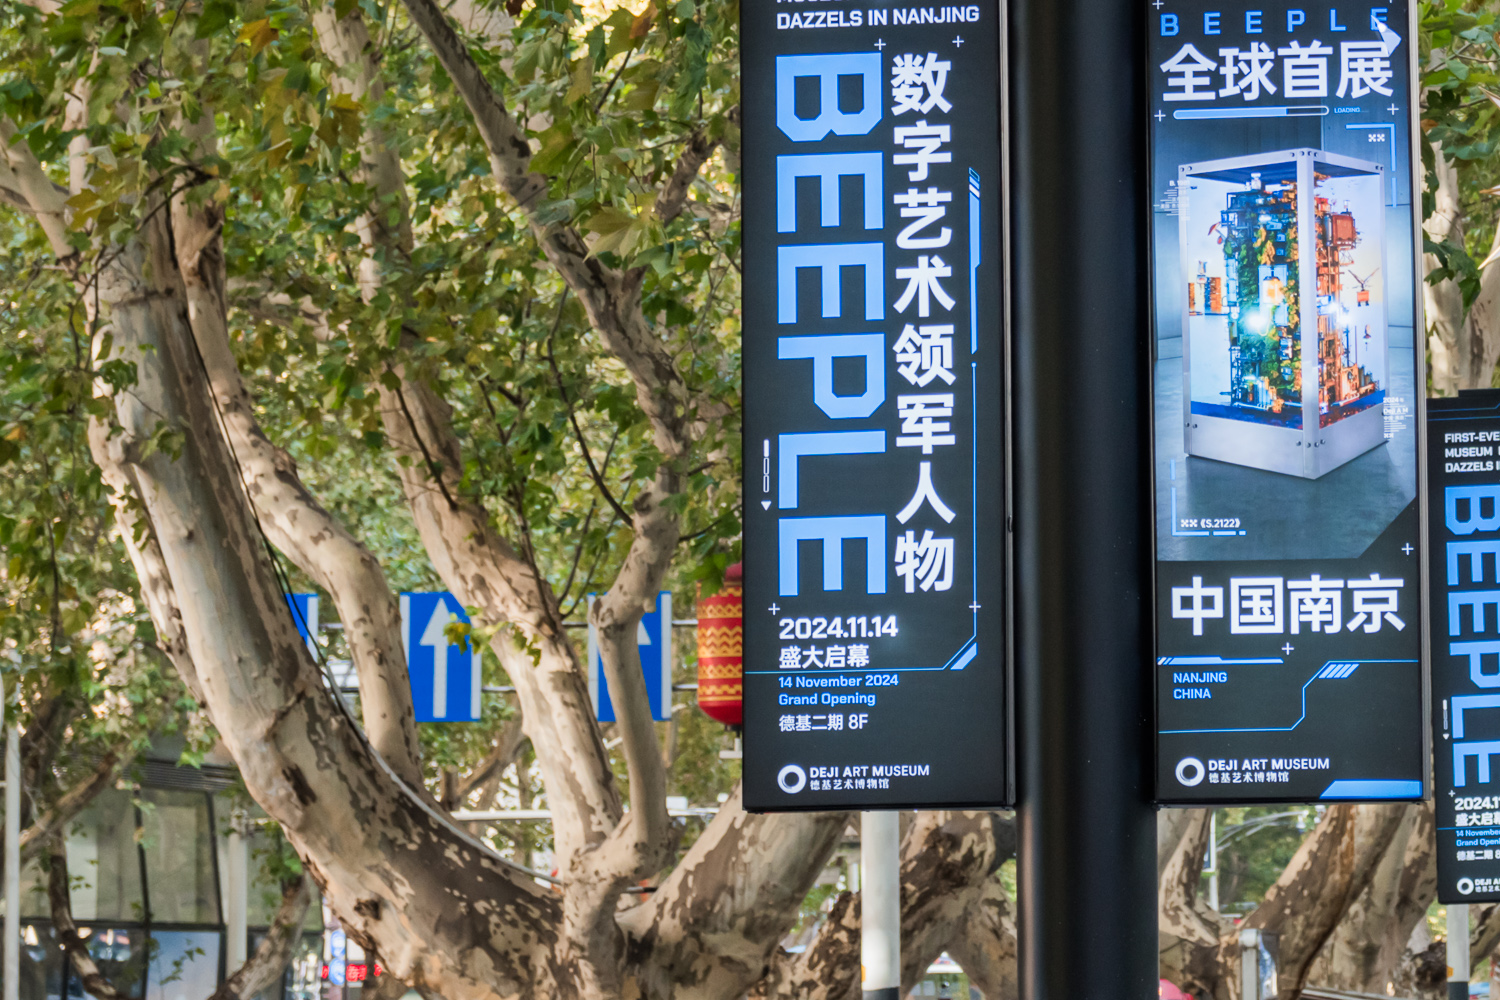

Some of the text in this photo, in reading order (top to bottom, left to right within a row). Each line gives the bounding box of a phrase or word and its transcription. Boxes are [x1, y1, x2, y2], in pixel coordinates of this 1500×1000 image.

[777, 6, 980, 29] DAZZELS IN NANJING
[1160, 39, 1394, 101] 全球首展
[776, 52, 887, 597] BEEPLE
[891, 52, 956, 593] 数字艺术领军人物
[1445, 447, 1493, 458] MUSEUM
[1445, 461, 1493, 473] DAZZELS
[1172, 573, 1405, 636] 中国南京
[779, 615, 898, 640] 2024.11.14
[779, 644, 869, 669] 盛大启幕
[778, 674, 899, 688] 14 November 2024
[1174, 672, 1227, 684] NANJING
[778, 692, 876, 707] Grand Opening
[1173, 689, 1211, 700] CHINA
[779, 714, 868, 732] 德基二期 8F
[1208, 758, 1330, 770] DEJI ART MUSEUM
[810, 765, 930, 778] DEJI ART MUSEUM
[1209, 771, 1289, 783] 德基艺术博物馆
[810, 779, 890, 790] 德基艺术博物馆
[1475, 878, 1491, 886] DEJI
